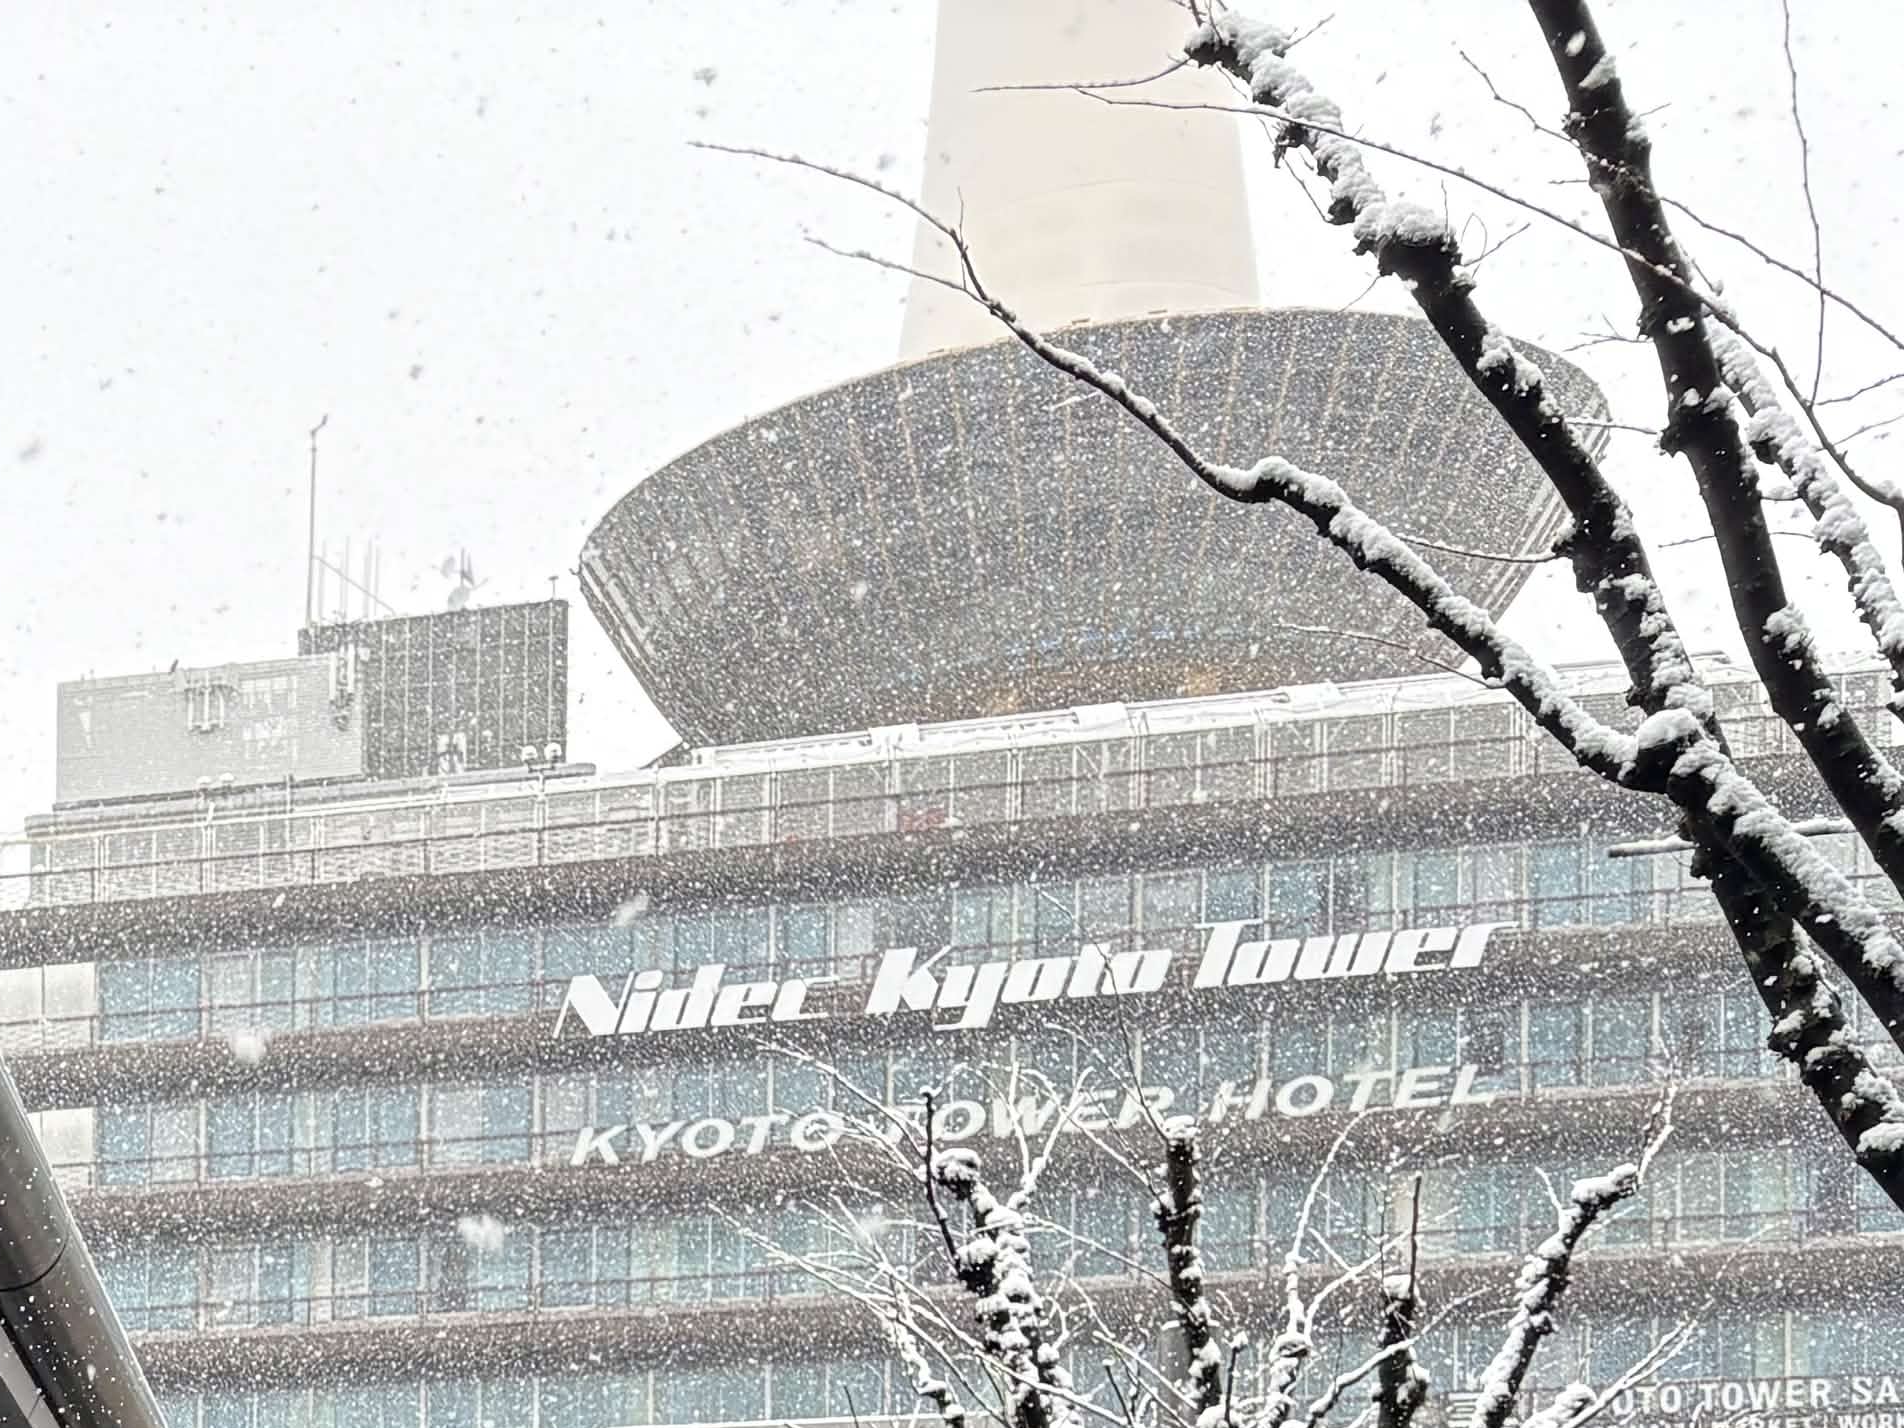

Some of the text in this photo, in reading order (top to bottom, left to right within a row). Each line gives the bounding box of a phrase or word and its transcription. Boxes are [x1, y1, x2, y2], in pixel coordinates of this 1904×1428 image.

[551, 918, 1519, 1038] Nidec Kyoto Tower
[569, 1113, 844, 1167] KYOTO
[1209, 1065, 1498, 1122] HOTEL
[1700, 1378, 1832, 1412] TOWER
